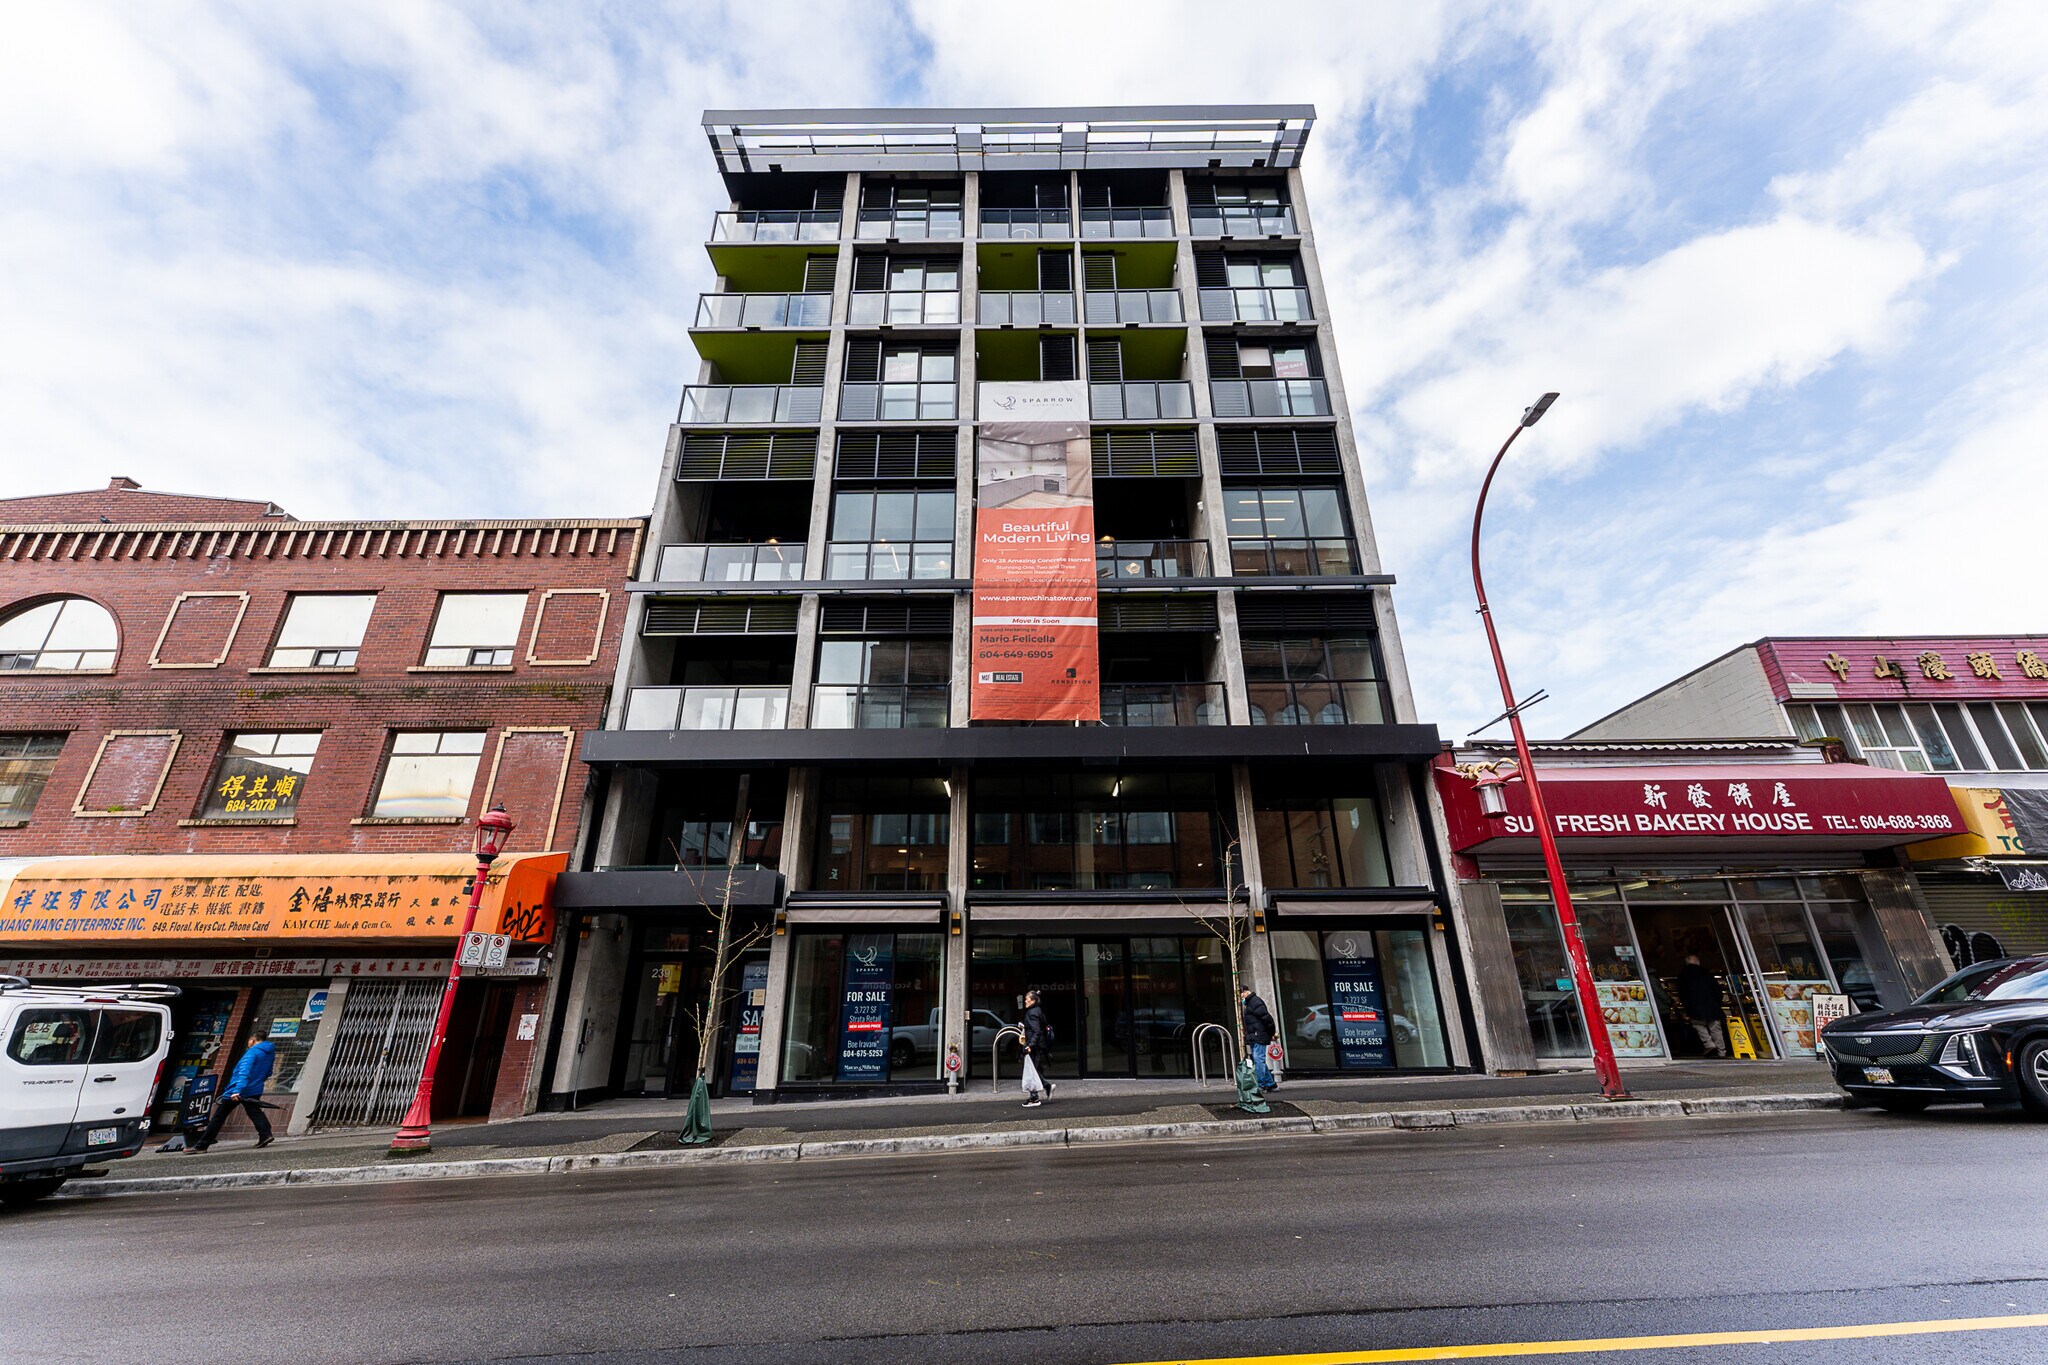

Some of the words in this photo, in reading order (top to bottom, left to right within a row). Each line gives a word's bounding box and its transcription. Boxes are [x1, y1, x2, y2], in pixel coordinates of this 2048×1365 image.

[1003, 521, 1069, 532] Beautiful
[984, 533, 1041, 543] Modern
[1046, 532, 1090, 544] Living
[980, 594, 1092, 602] www.sparrowchinatown.com
[980, 635, 1009, 643] Mario
[1012, 635, 1056, 643] Felicella
[979, 650, 1053, 659] 604-649-6905
[1643, 782, 1796, 810] 新發餅屋
[225, 798, 277, 812] 684-2078
[1505, 815, 1534, 833] SU
[1557, 814, 1630, 832] FRESH
[1635, 813, 1725, 831] BAKERY
[1732, 812, 1813, 831] HOUSE
[1822, 814, 1859, 830] TEL:
[1859, 814, 1952, 830] 604-688-3868
[13, 888, 162, 914] 祥旺有限公司
[0, 918, 32, 932] XIANG
[32, 918, 63, 932] WANG
[64, 917, 125, 932] ENTERPRISE
[126, 917, 146, 932] INC.
[228, 921, 252, 932] Phone
[252, 921, 270, 932] Card
[282, 920, 308, 930] KAM
[308, 920, 331, 930] CHE
[333, 921, 351, 930] Jade
[352, 921, 359, 931] &
[361, 921, 379, 930] Gem
[380, 920, 392, 929] Co.
[1095, 951, 1112, 961] 243
[652, 968, 671, 978] 239
[754, 966, 767, 977] 24
[1334, 982, 1351, 992] FOR
[1353, 981, 1374, 992] SALE
[847, 991, 863, 1002] FOR
[866, 991, 886, 1002] SALE
[742, 1010, 764, 1026] SA
[843, 1049, 883, 1057] 604-675-5253
